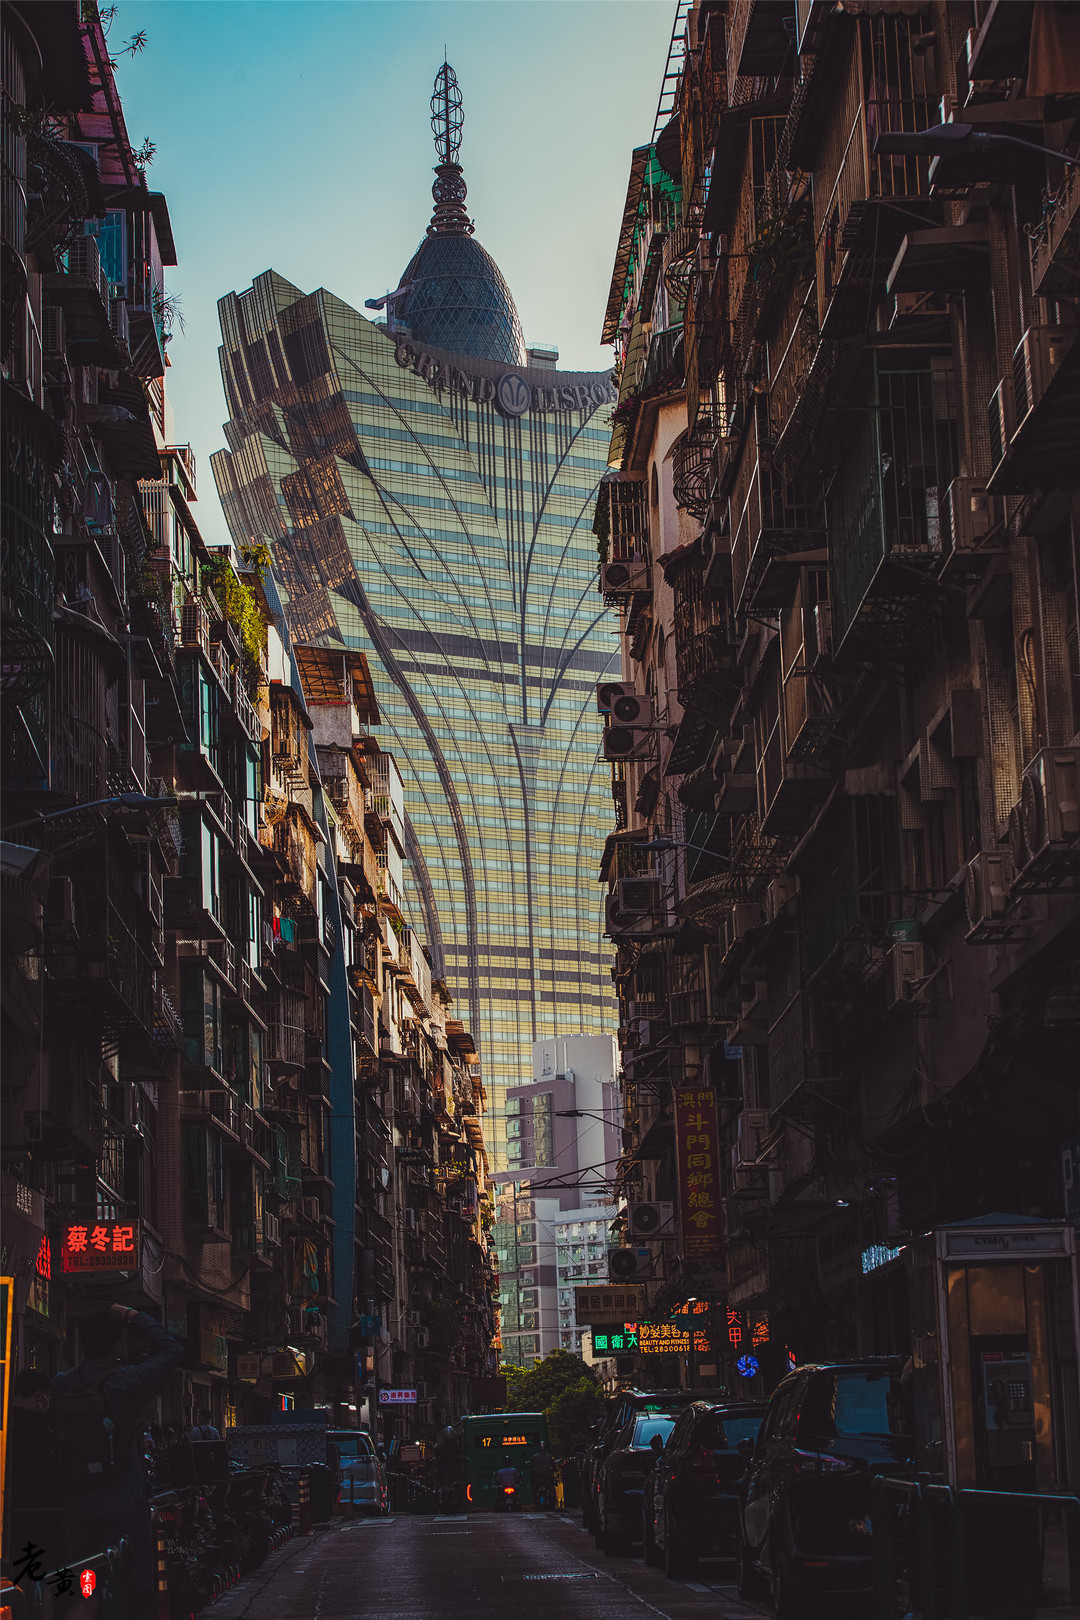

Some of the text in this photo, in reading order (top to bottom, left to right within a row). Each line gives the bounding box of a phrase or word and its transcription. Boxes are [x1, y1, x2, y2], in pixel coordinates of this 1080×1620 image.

[394, 342, 620, 411] GRAND LISBOA
[678, 1092, 714, 1108] 澳門
[684, 1113, 716, 1229] 斗門同鄉總會
[67, 1225, 135, 1252] 蔡冬記
[482, 1437, 492, 1447] 17
